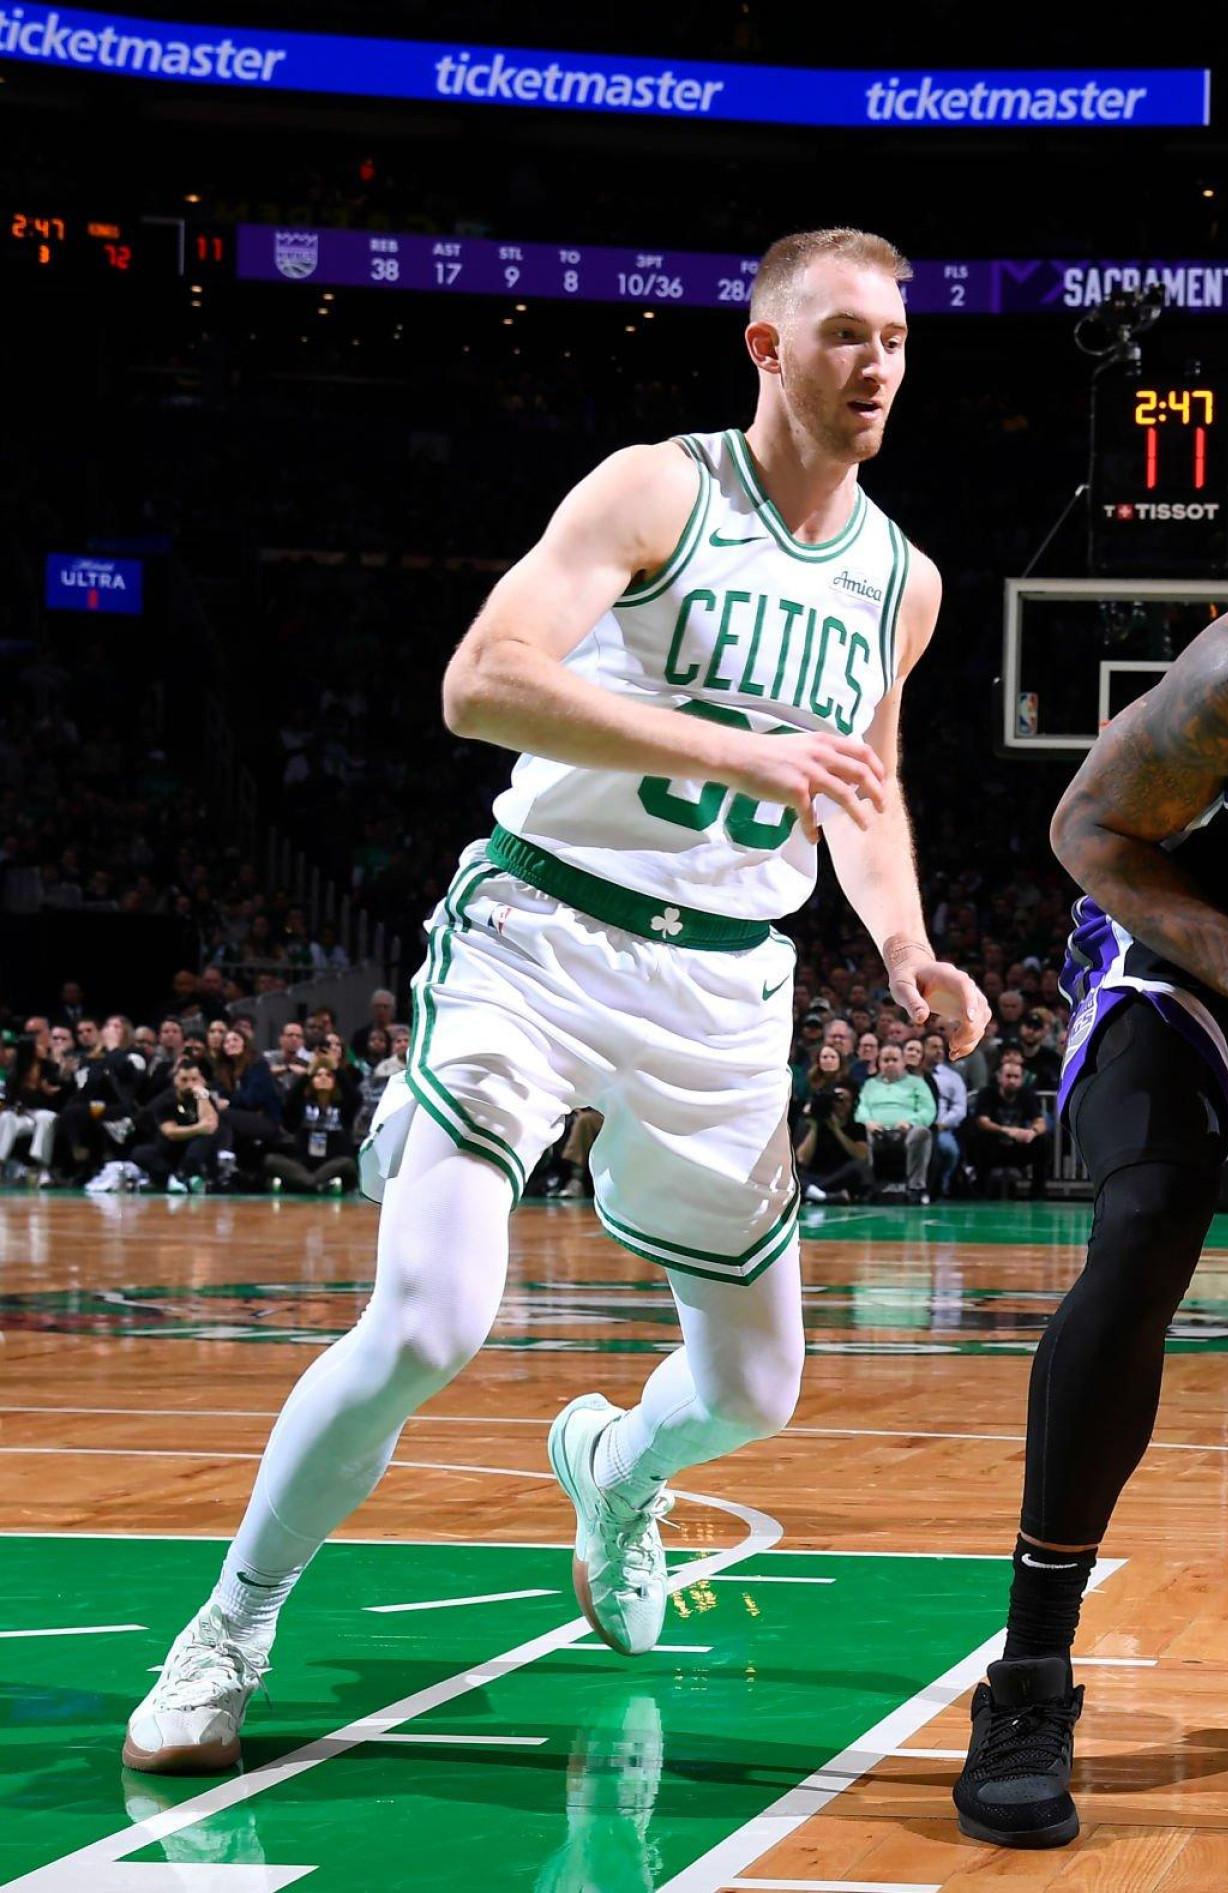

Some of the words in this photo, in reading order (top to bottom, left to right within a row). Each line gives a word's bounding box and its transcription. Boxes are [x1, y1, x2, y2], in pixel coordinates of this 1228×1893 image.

[435, 52, 724, 112] ticketmaster
[866, 76, 1147, 121] ticketmaster
[432, 242, 461, 257] AST
[499, 246, 523, 261] STL
[559, 249, 581, 265] TO
[635, 254, 663, 269] 3PT
[944, 265, 969, 279] FLS
[370, 257, 400, 282] 38
[435, 261, 463, 285] 17
[504, 265, 520, 288] 9
[563, 270, 579, 293] 8
[617, 273, 684, 299] 10/36
[950, 284, 965, 307] 2
[1134, 389, 1214, 426] 2:47
[1146, 426, 1206, 489] 11
[1133, 503, 1220, 520] TISSOT
[60, 568, 127, 591] ULTRA
[832, 570, 883, 602] Amica
[663, 587, 871, 737] CELTICS
